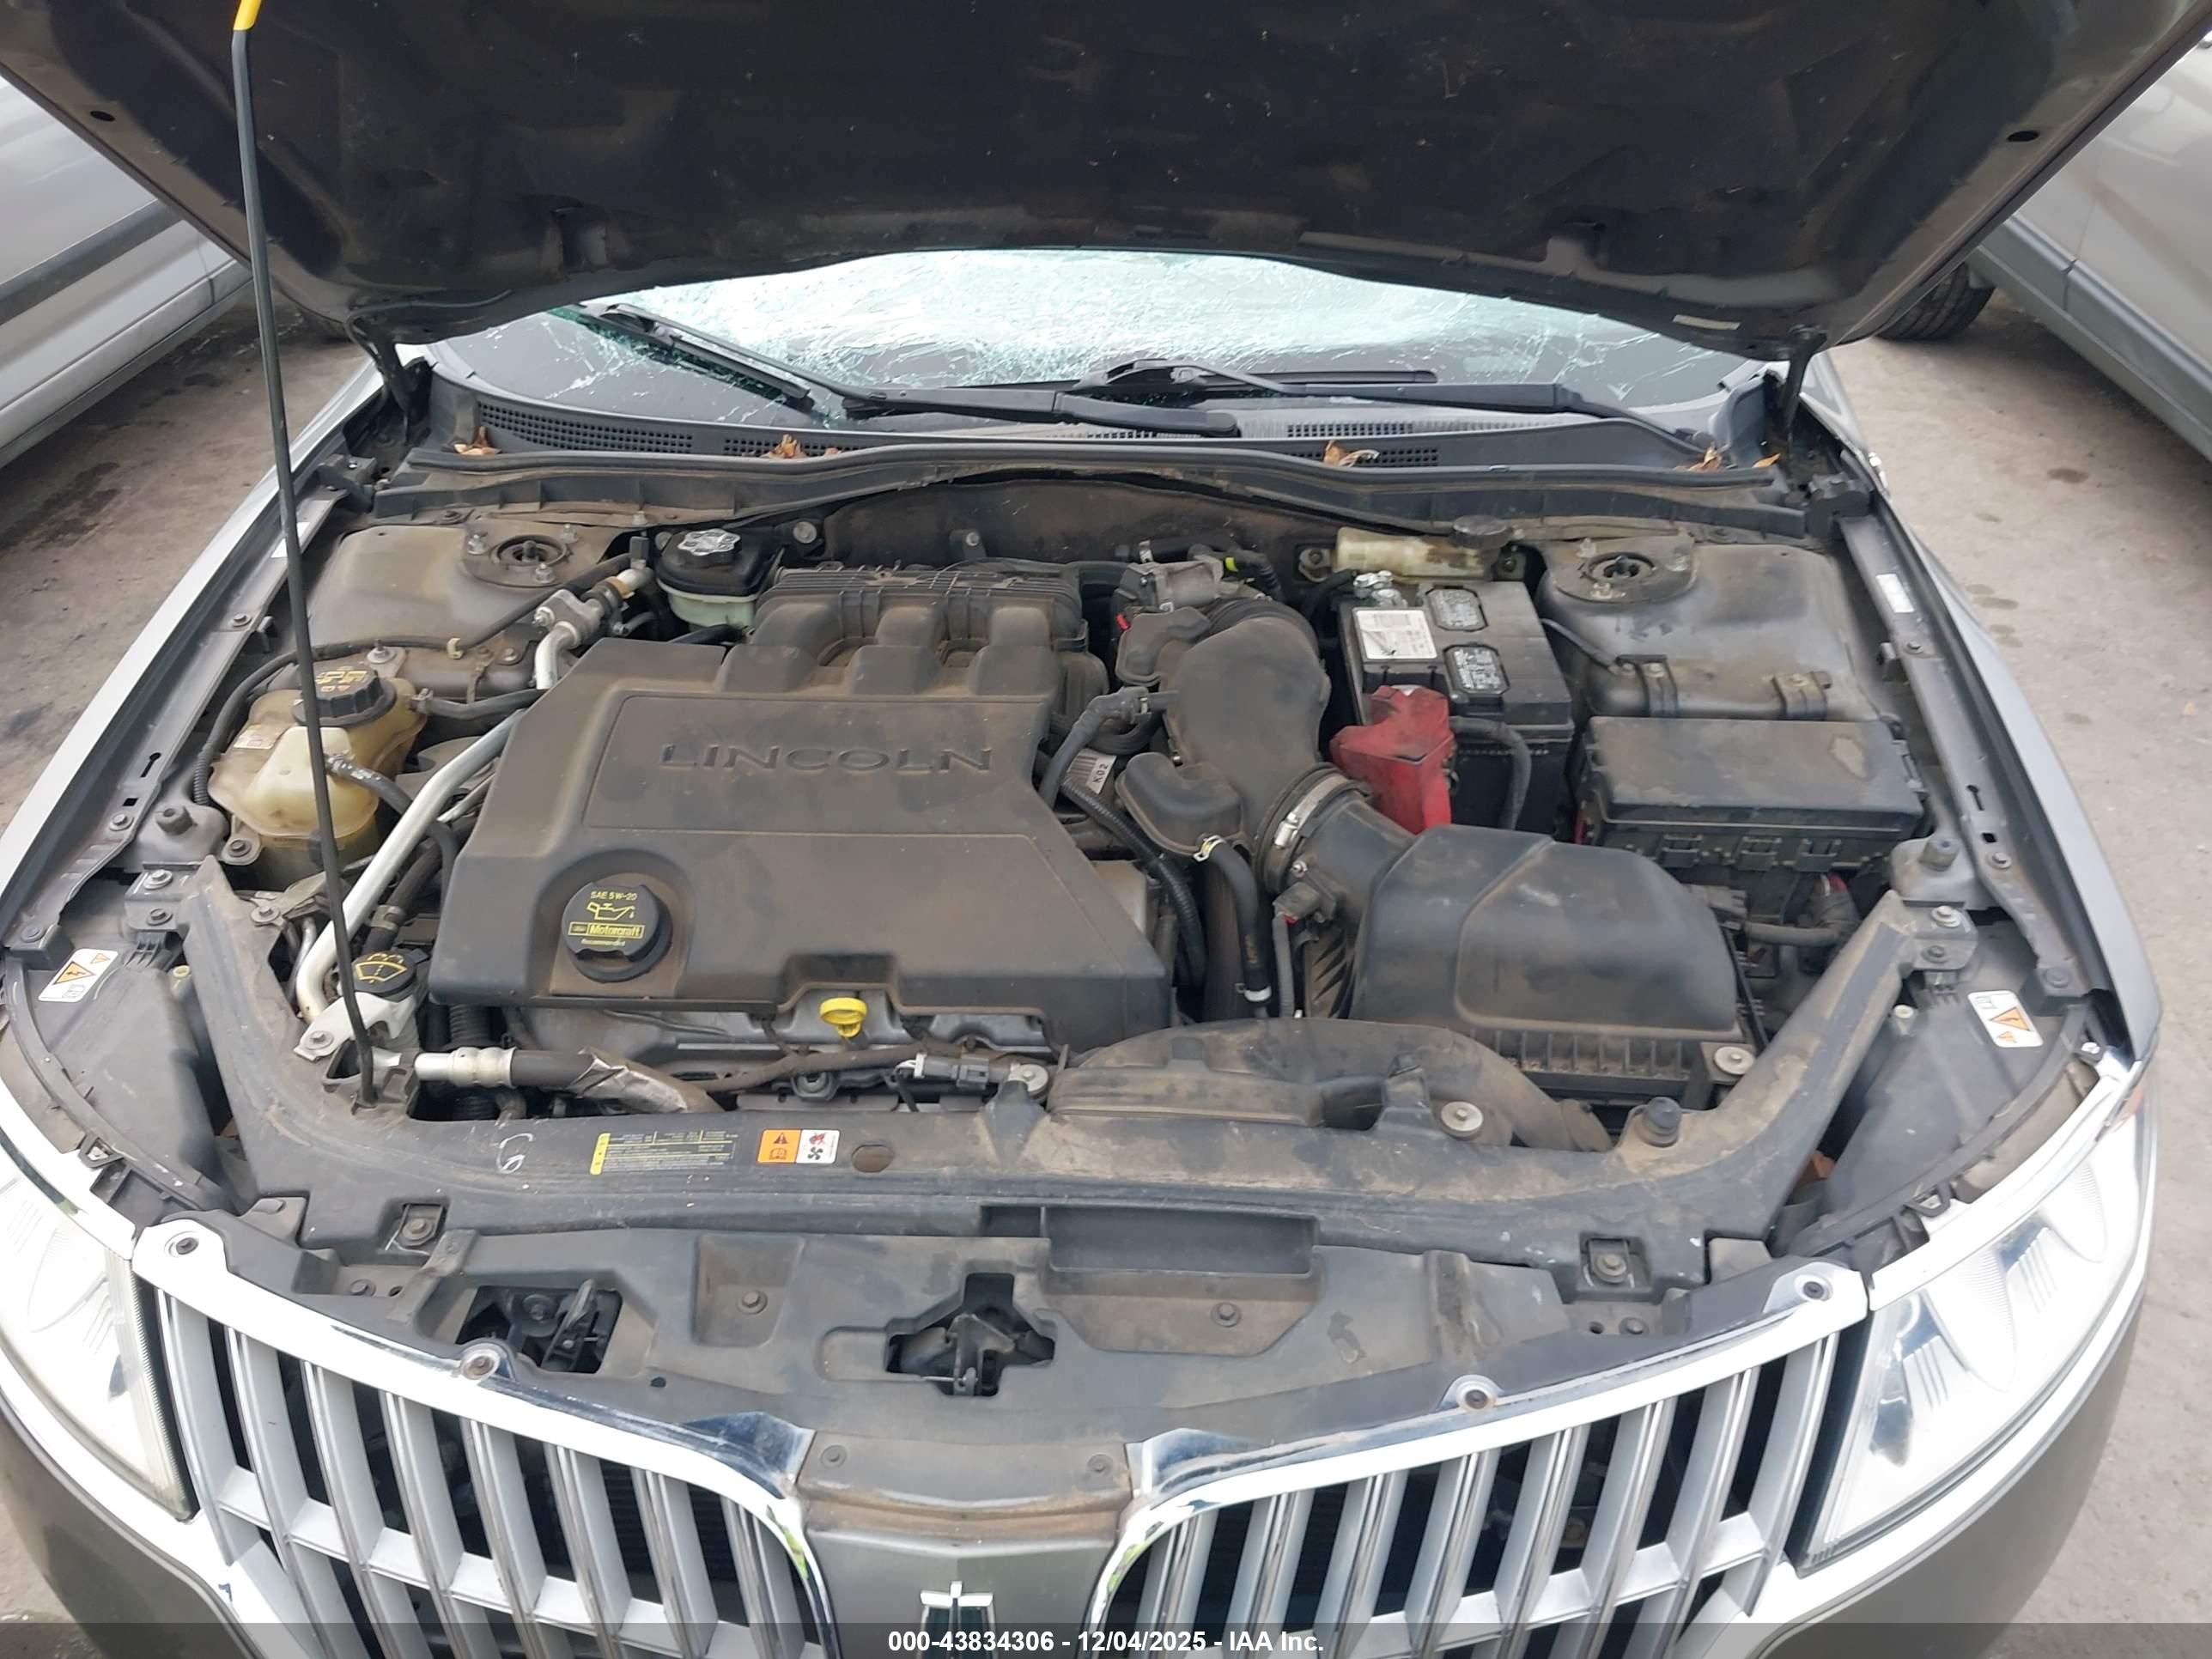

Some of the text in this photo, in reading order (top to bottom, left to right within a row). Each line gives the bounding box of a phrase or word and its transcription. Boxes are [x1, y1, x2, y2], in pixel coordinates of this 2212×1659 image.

[662, 744, 993, 774] LINCOLN
[590, 890, 638, 901] SAE 5W-20
[589, 925, 641, 937] Motorcraft
